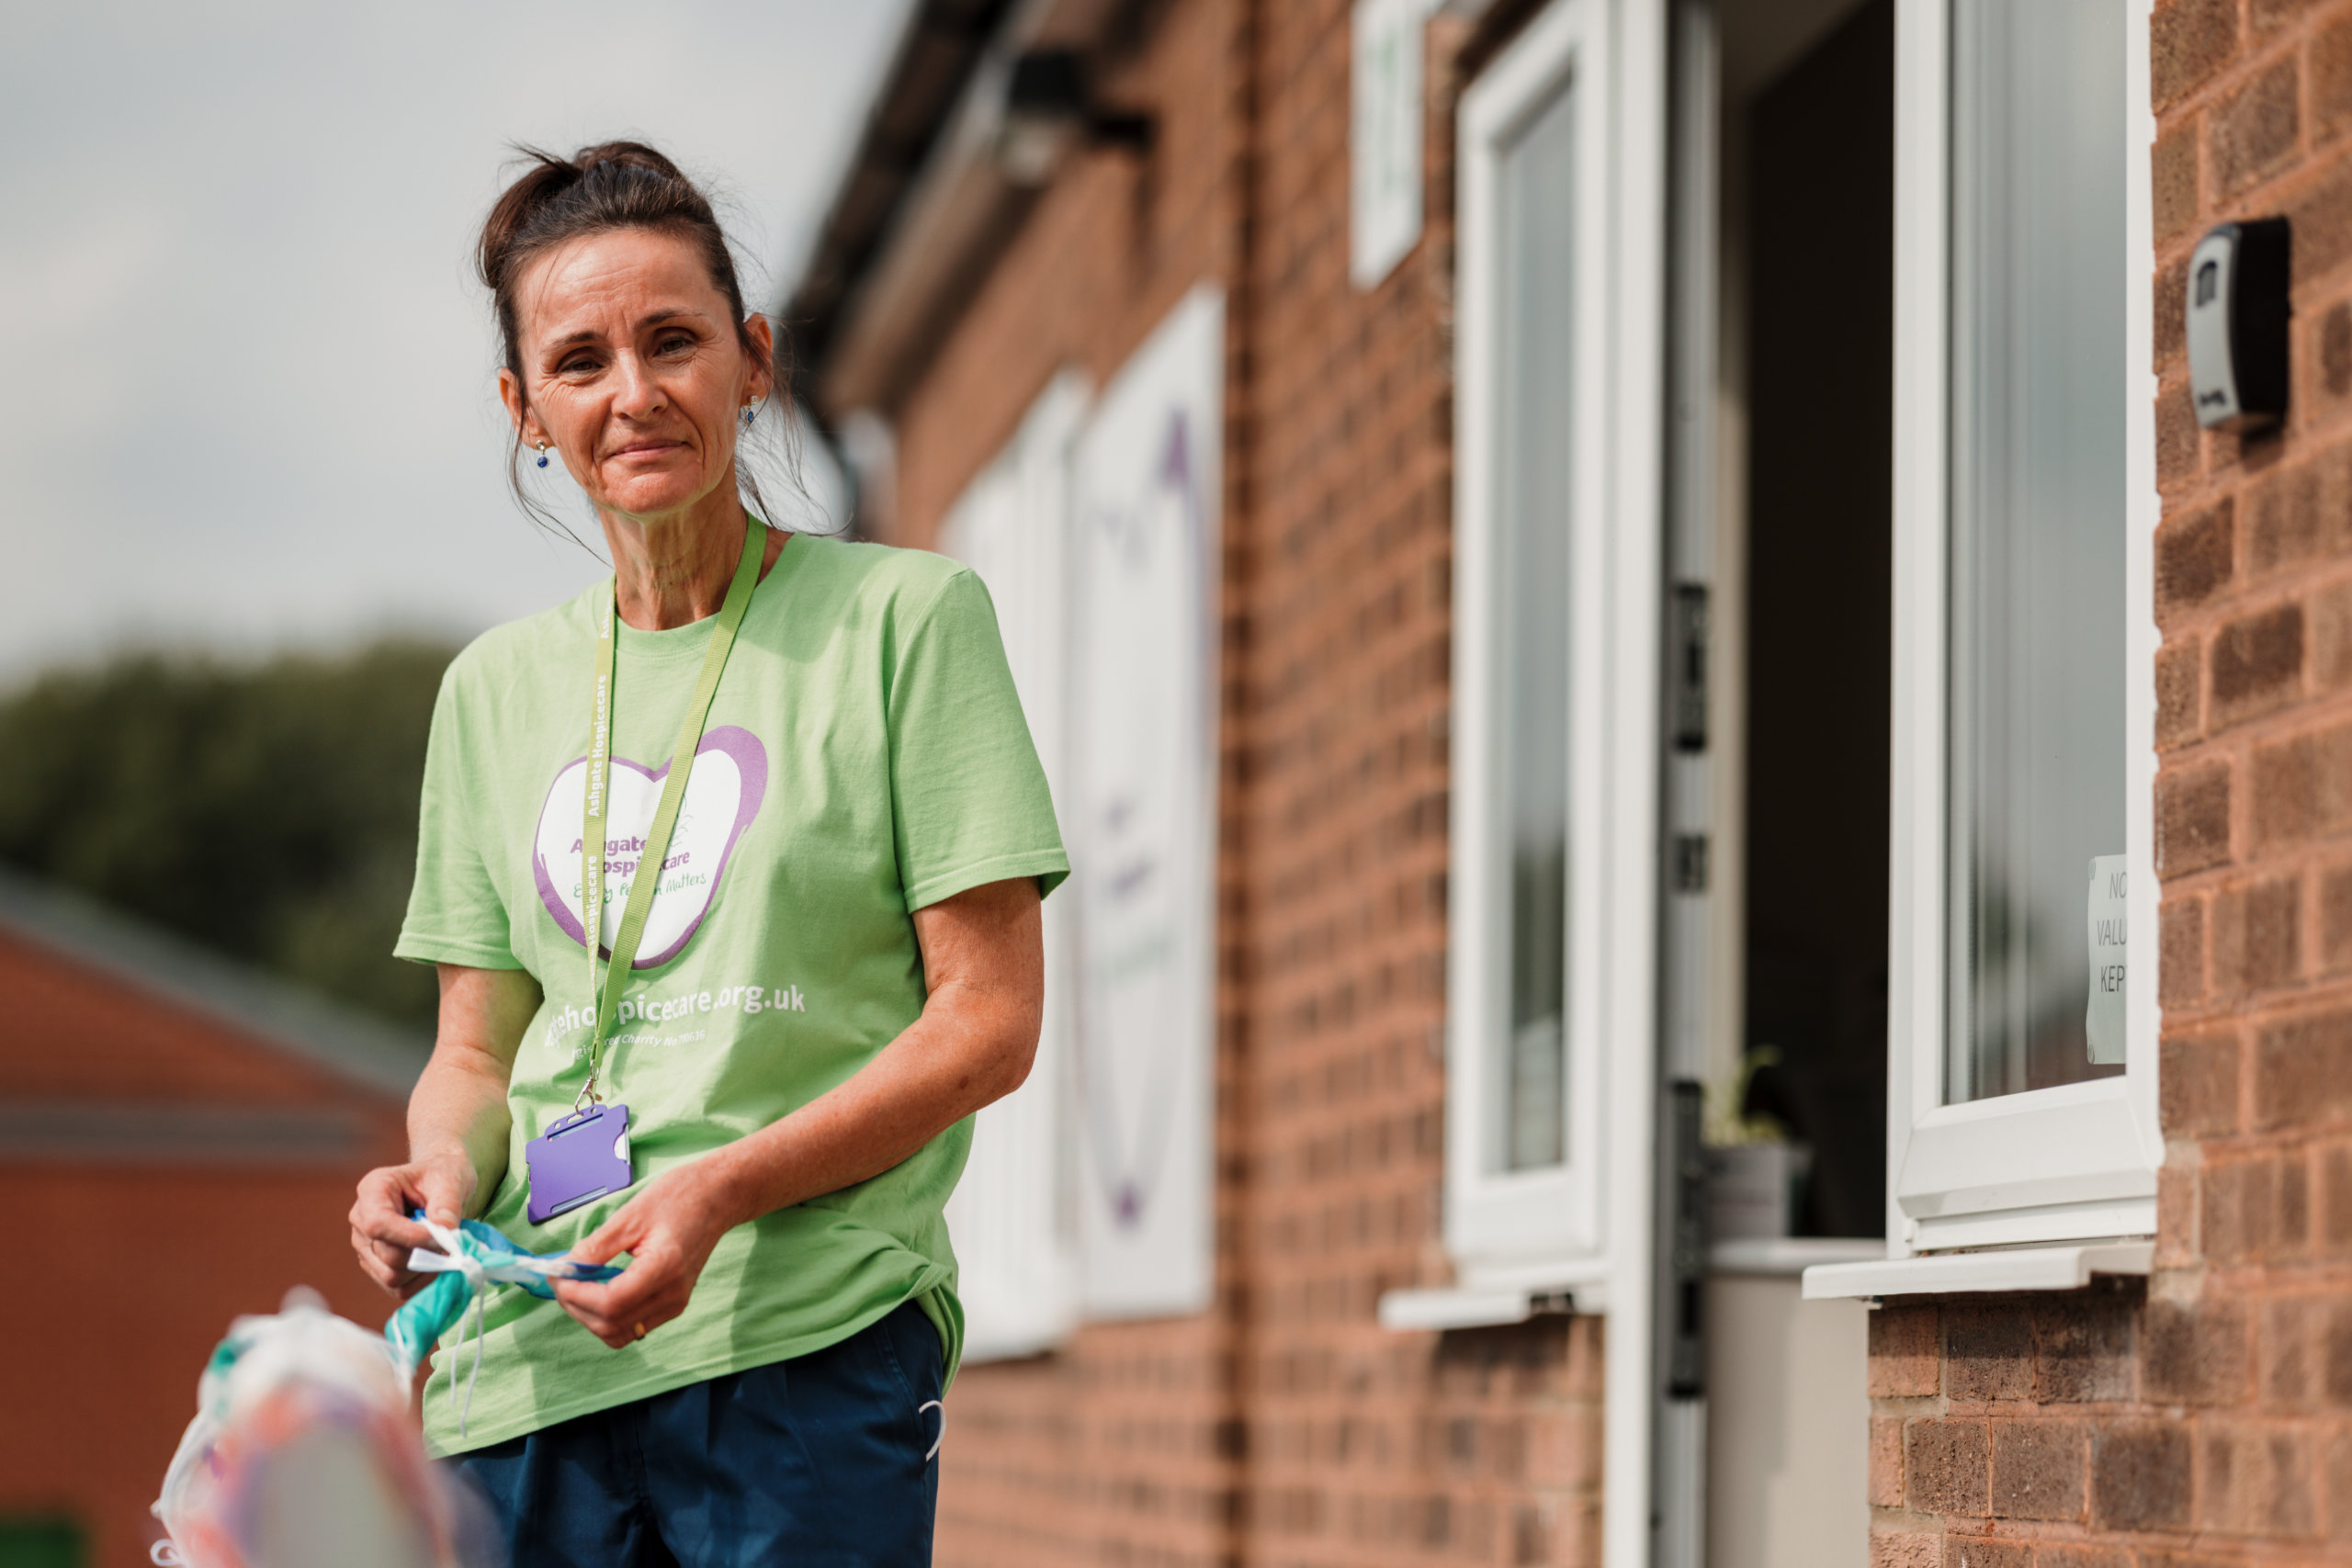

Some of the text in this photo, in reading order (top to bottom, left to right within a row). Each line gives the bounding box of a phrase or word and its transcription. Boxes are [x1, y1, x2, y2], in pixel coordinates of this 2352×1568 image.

[588, 675, 606, 817] Ashgate Hospicecare
[570, 836, 647, 856] Agat
[603, 852, 690, 877] ospicare
[666, 873, 706, 894] Matters
[586, 855, 598, 946] Hospicecare
[2097, 919, 2127, 947] VALU
[2100, 964, 2127, 993] KEP
[621, 1034, 662, 1047] Charity
[663, 1037, 677, 1046] No
